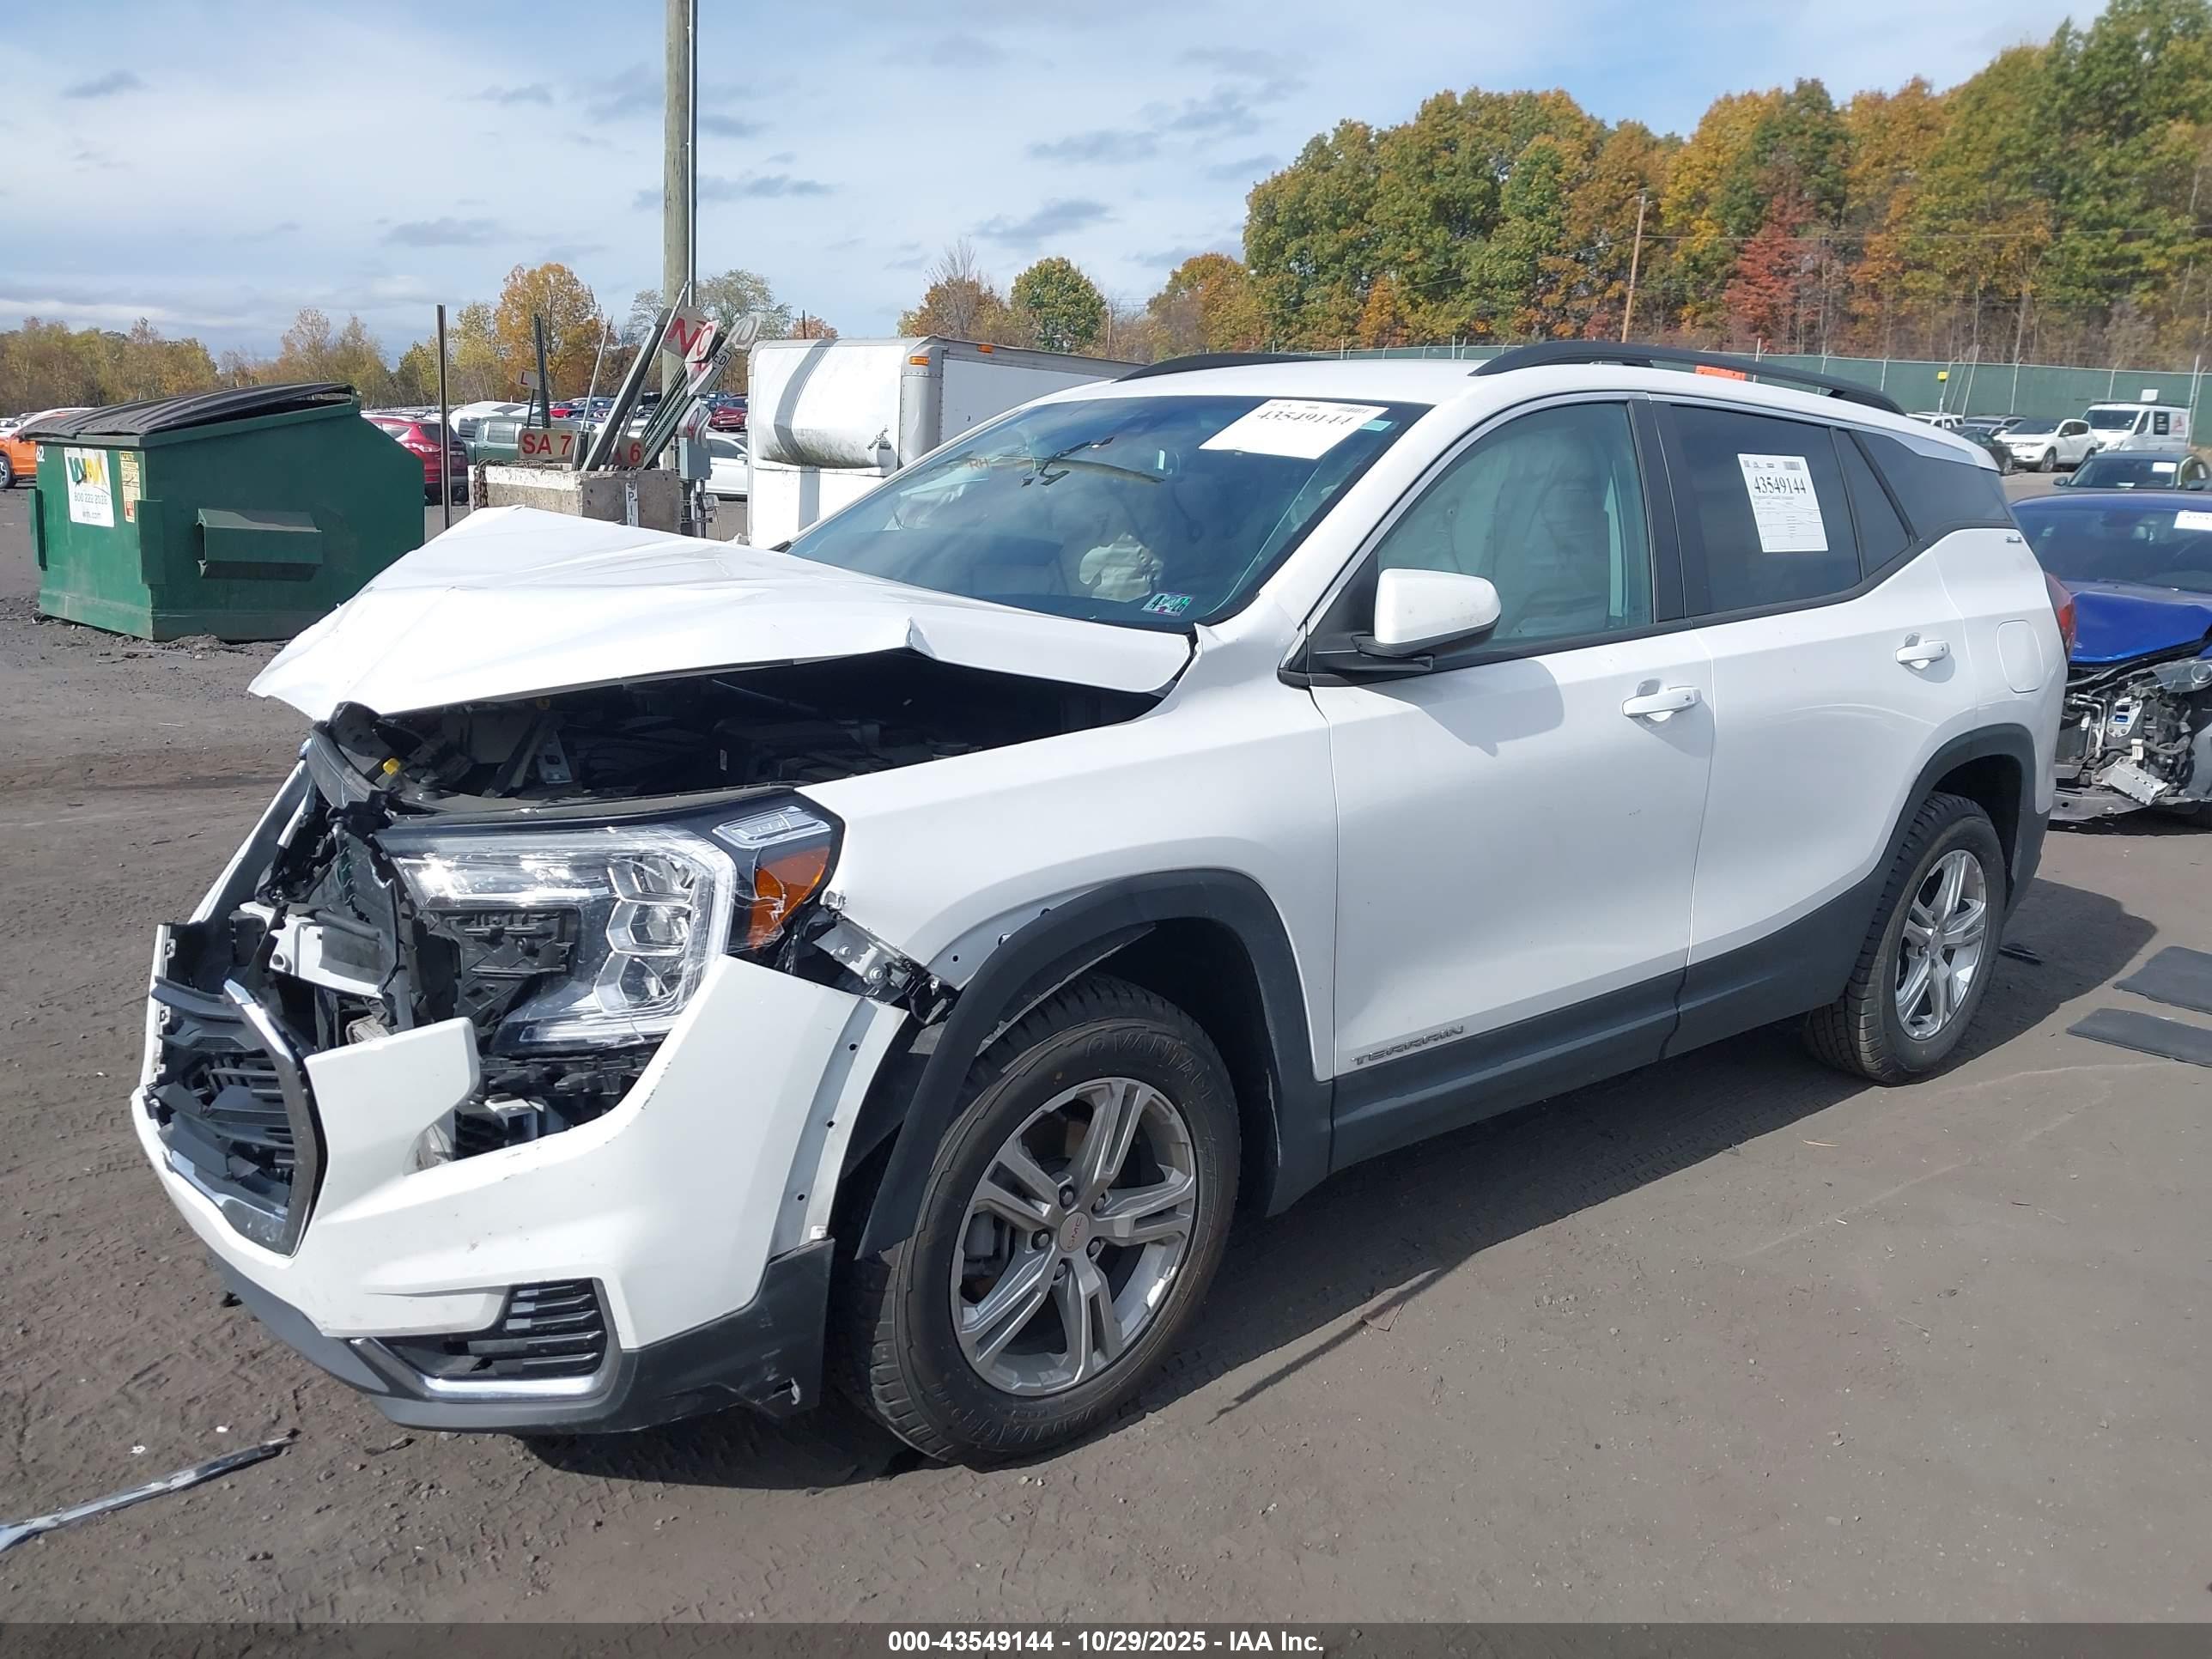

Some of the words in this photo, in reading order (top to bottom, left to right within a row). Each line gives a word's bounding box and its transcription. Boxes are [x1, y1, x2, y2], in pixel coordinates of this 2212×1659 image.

[521, 433, 552, 455] SA
[560, 434, 573, 455] 7
[629, 441, 642, 464] 6
[1754, 476, 1807, 495] 43549144
[1350, 1024, 1464, 1066] TERRAIN
